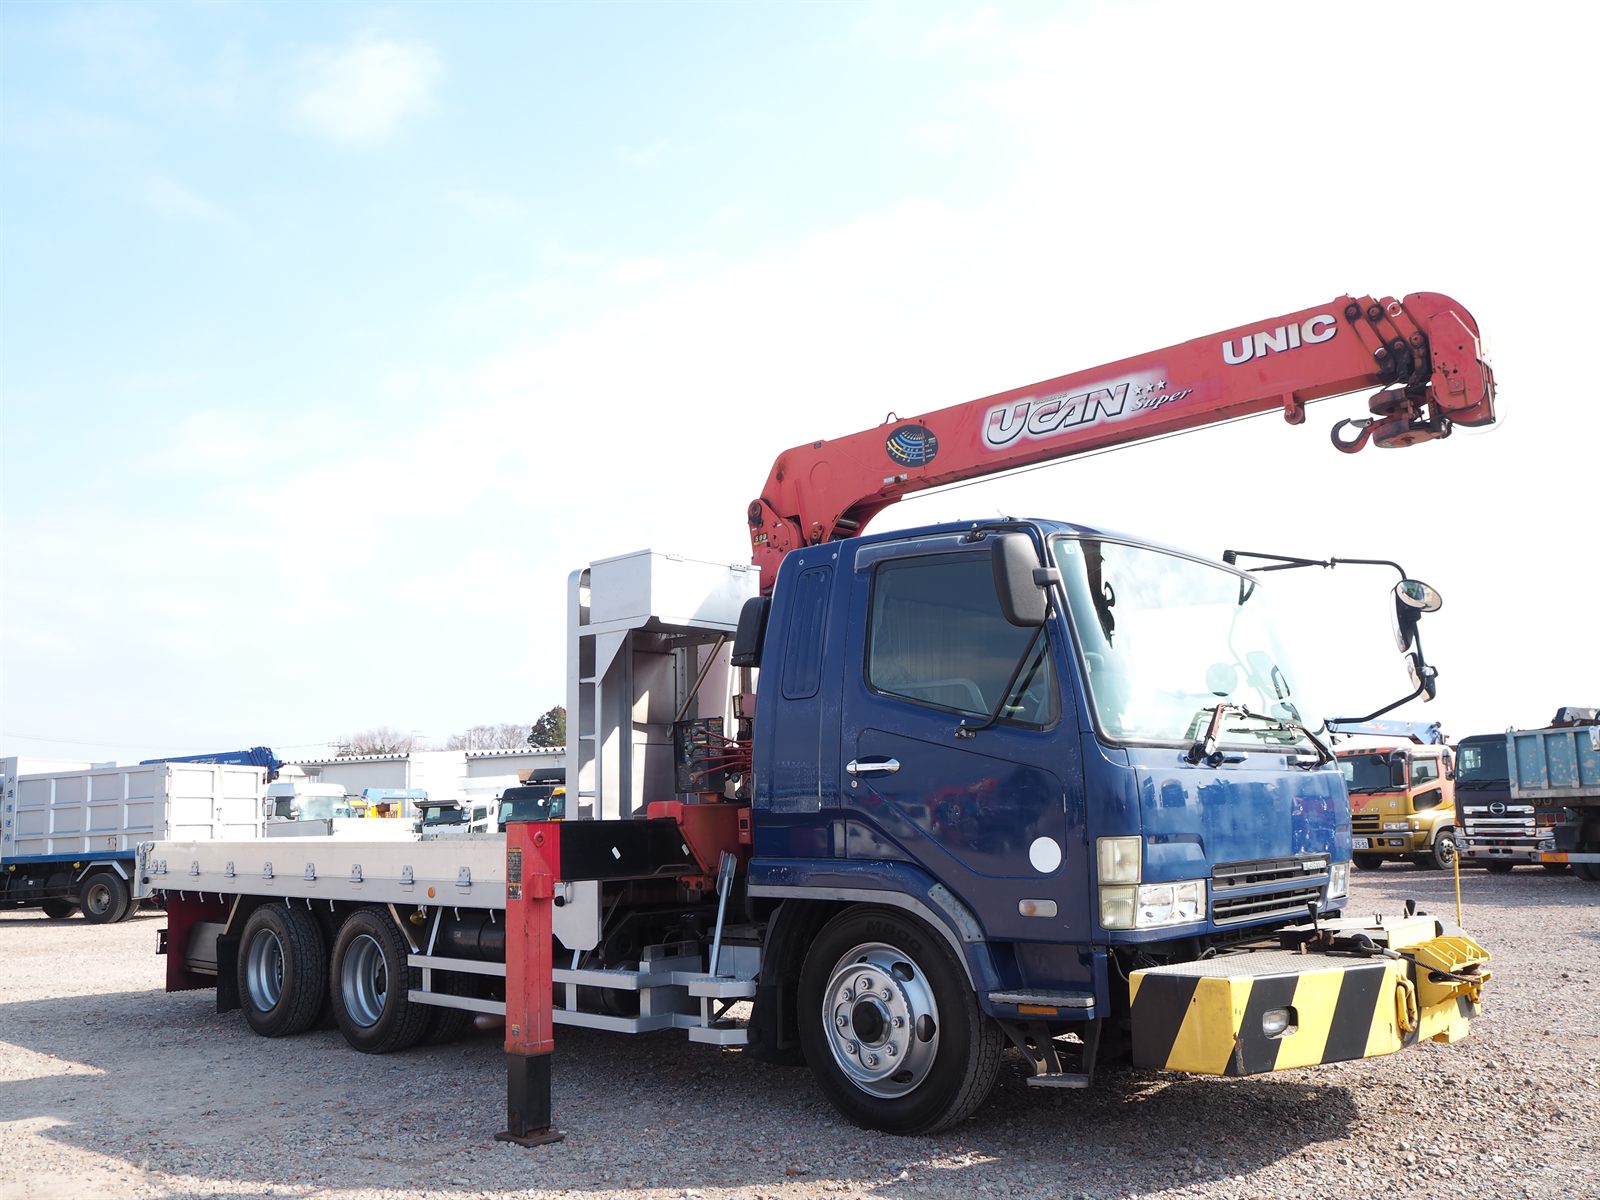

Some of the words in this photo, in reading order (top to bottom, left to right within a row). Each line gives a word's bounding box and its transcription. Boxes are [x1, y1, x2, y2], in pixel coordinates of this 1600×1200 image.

[1222, 314, 1338, 365] UNIC
[987, 383, 1130, 445] UCAN
[1131, 387, 1194, 412] Super
